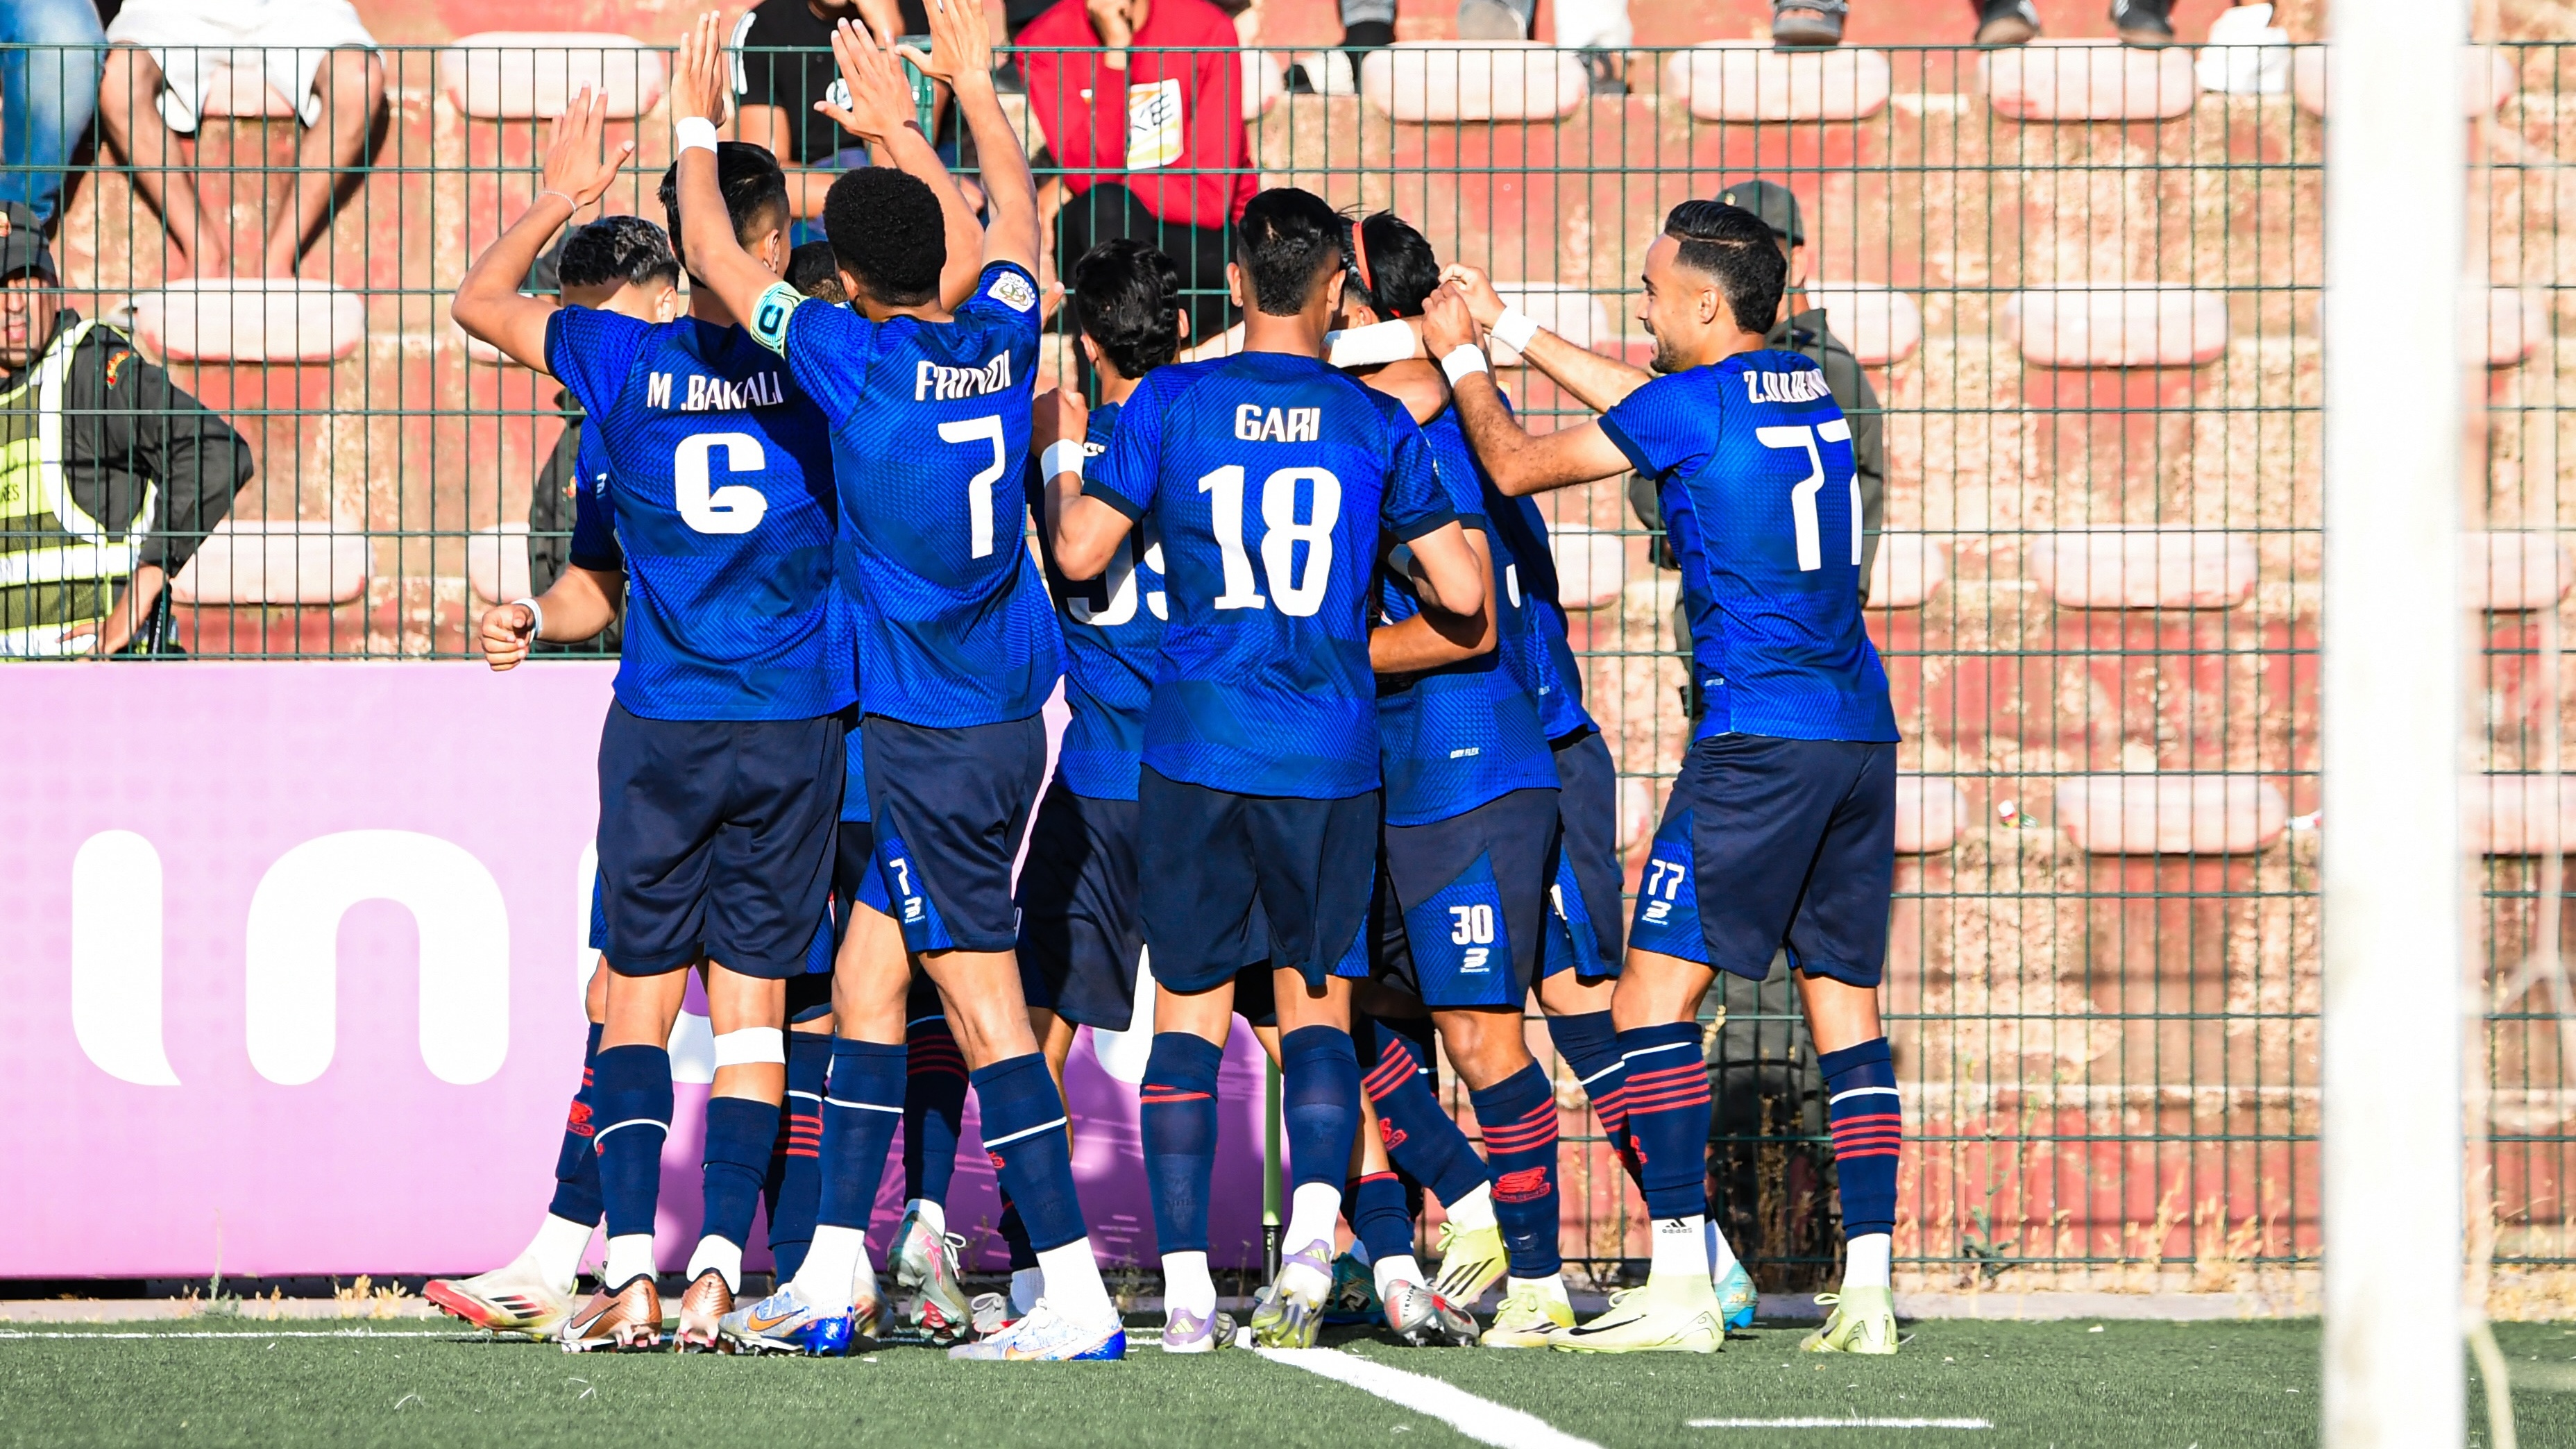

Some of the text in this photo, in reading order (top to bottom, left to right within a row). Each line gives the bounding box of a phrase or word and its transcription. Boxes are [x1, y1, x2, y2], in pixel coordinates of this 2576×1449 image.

[647, 371, 672, 409] M
[915, 349, 1012, 401] FRINDI
[1235, 403, 1321, 442] GARI
[675, 432, 768, 534] 6
[938, 414, 1006, 559] 7
[1198, 464, 1342, 617] 18
[889, 858, 910, 896] 7
[1647, 858, 1686, 900] 77
[1449, 904, 1494, 945] 30
